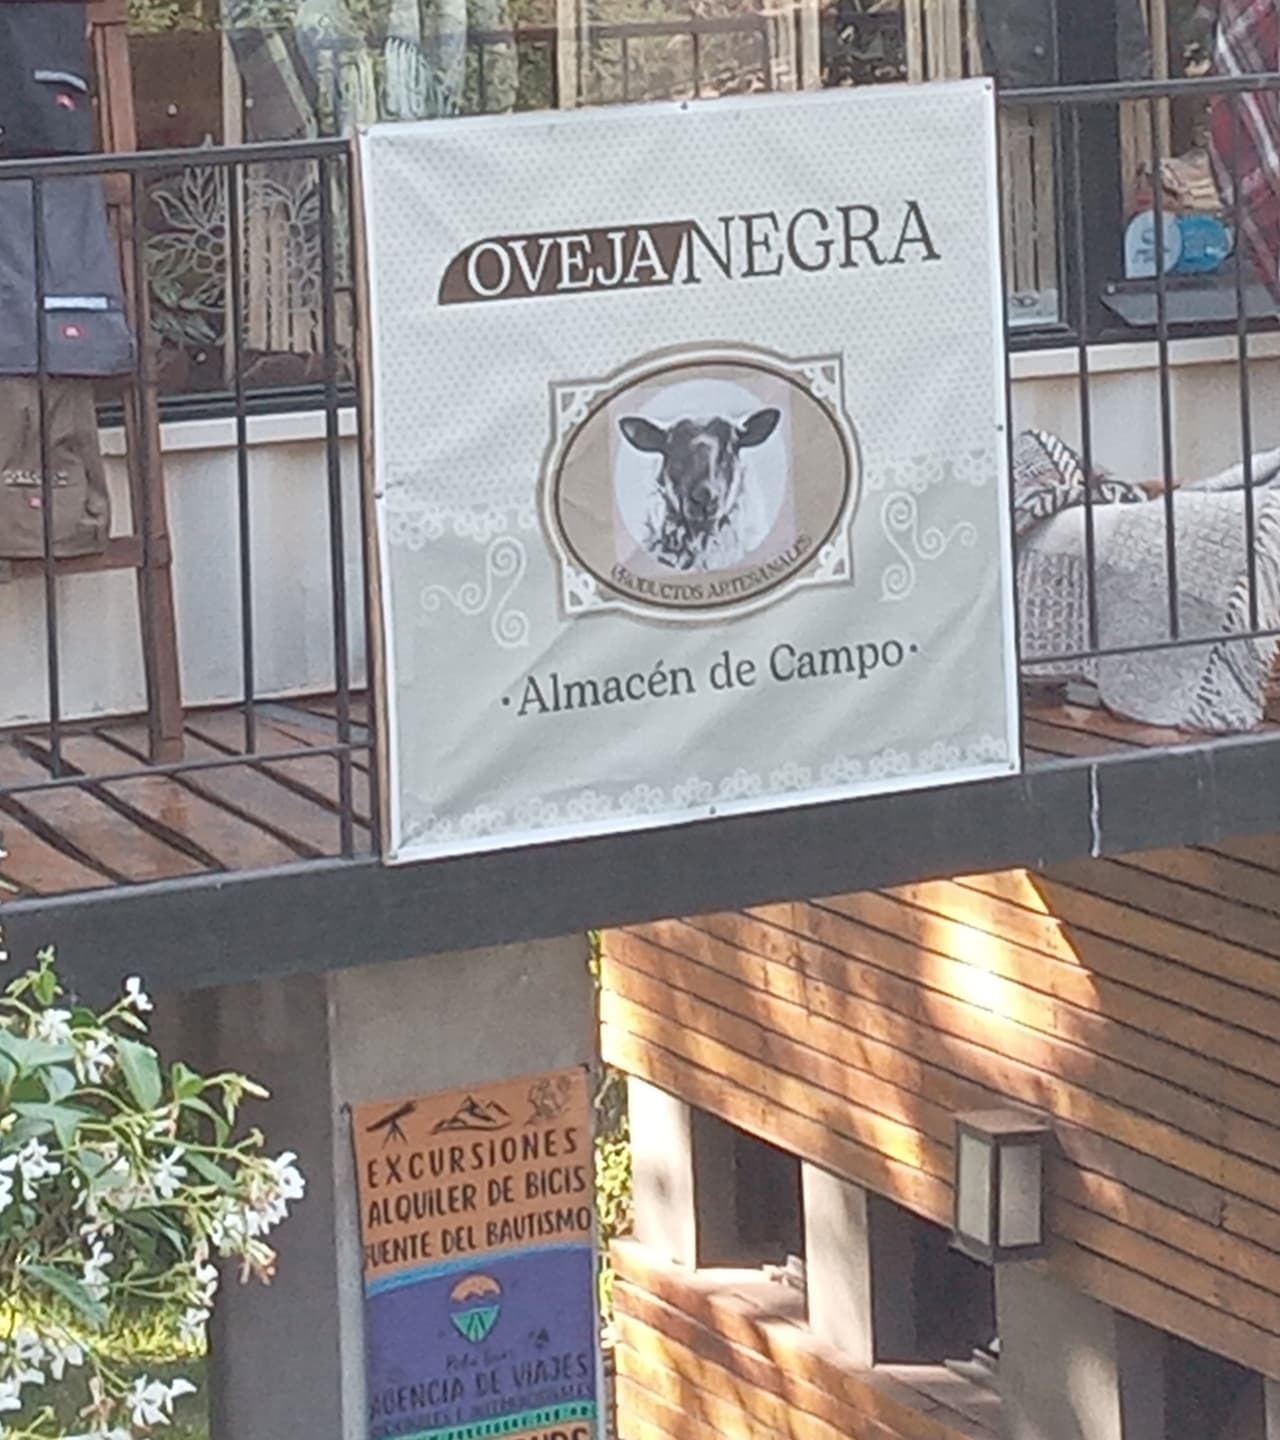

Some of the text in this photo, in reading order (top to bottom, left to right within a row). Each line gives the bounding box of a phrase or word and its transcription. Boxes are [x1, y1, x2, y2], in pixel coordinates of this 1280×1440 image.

[466, 200, 941, 297] OVEJA NEGRA
[709, 652, 757, 690] de
[367, 1127, 579, 1189] EXCURSIONES
[368, 1165, 587, 1229] ALQUILER DE BICIS
[441, 1225, 477, 1255] DEL
[486, 1205, 592, 1244] BAUTISMO
[476, 1370, 501, 1396] DE
[512, 1353, 588, 1389] VIAJES
